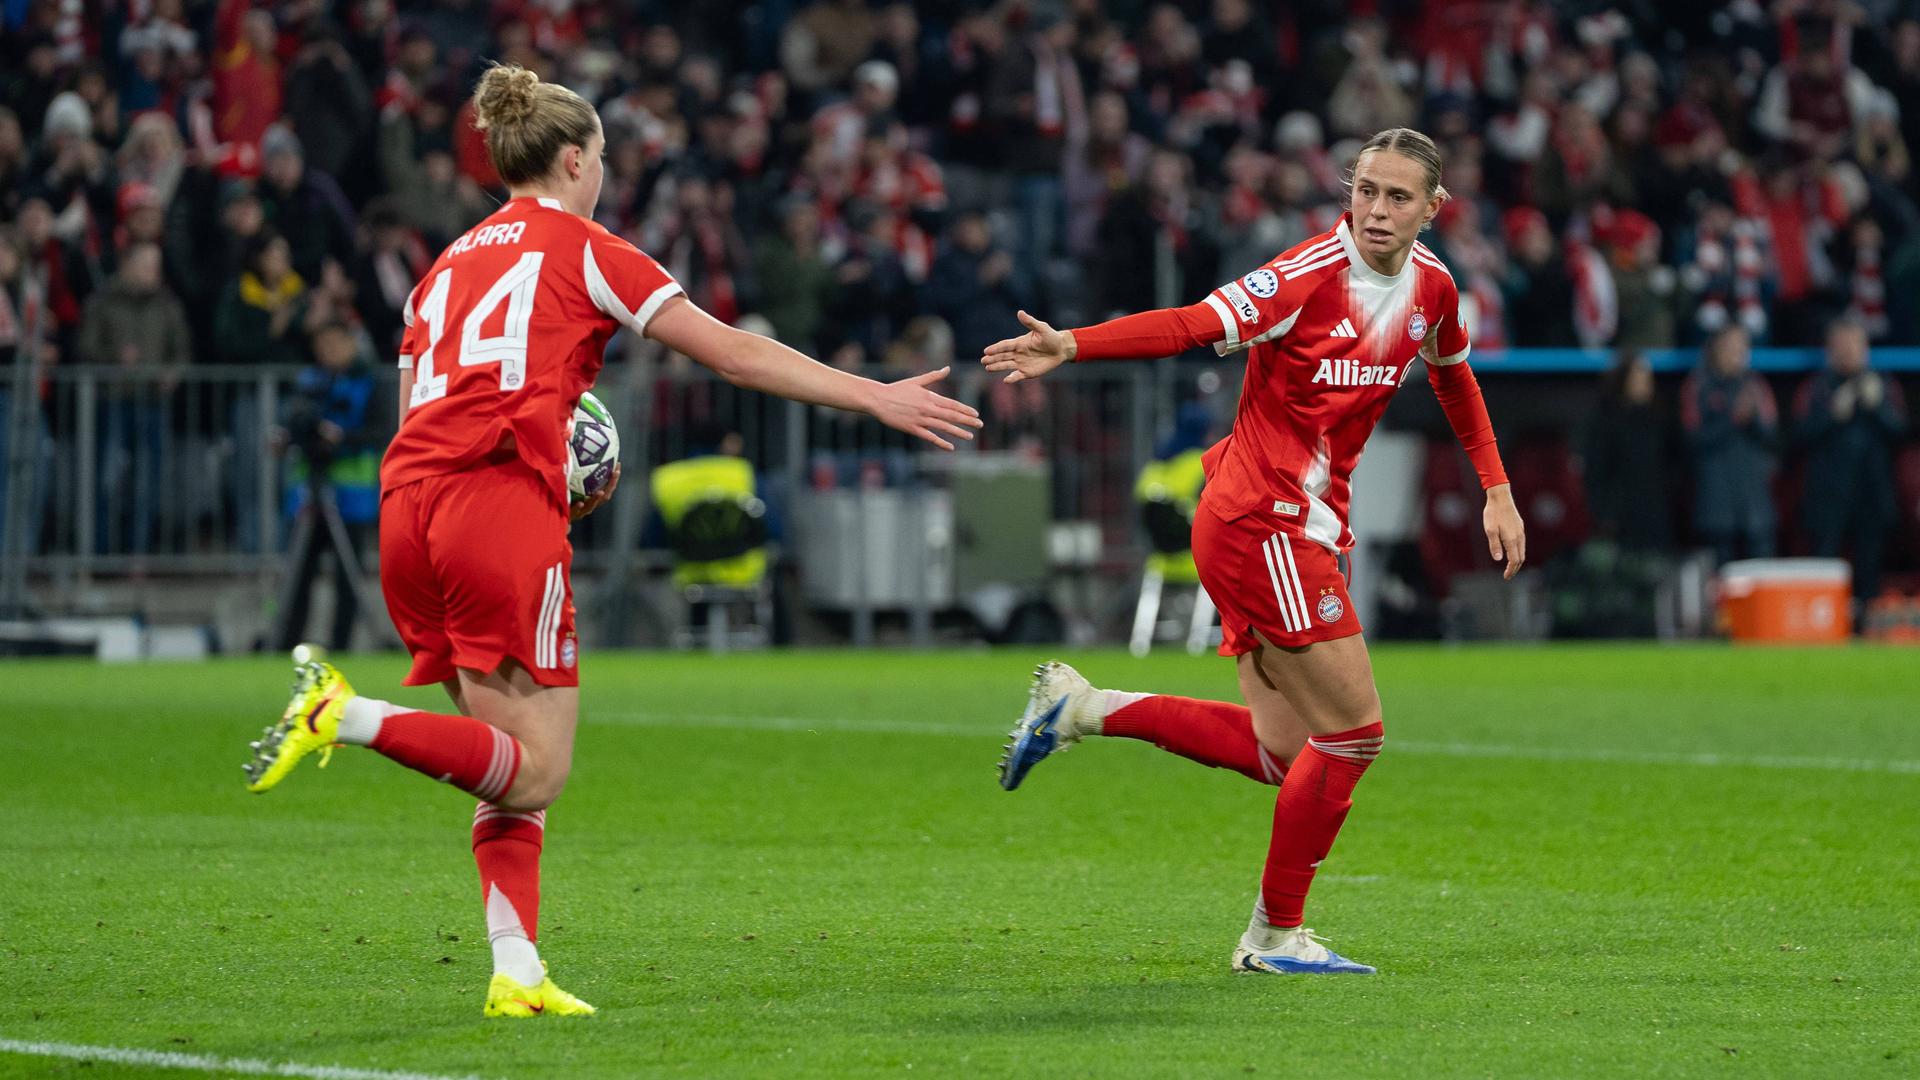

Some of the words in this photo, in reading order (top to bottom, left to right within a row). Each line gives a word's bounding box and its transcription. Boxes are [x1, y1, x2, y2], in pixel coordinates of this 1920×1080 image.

[447, 221, 526, 259] ALARA
[409, 251, 544, 409] 14
[1312, 358, 1397, 386] Allianz
